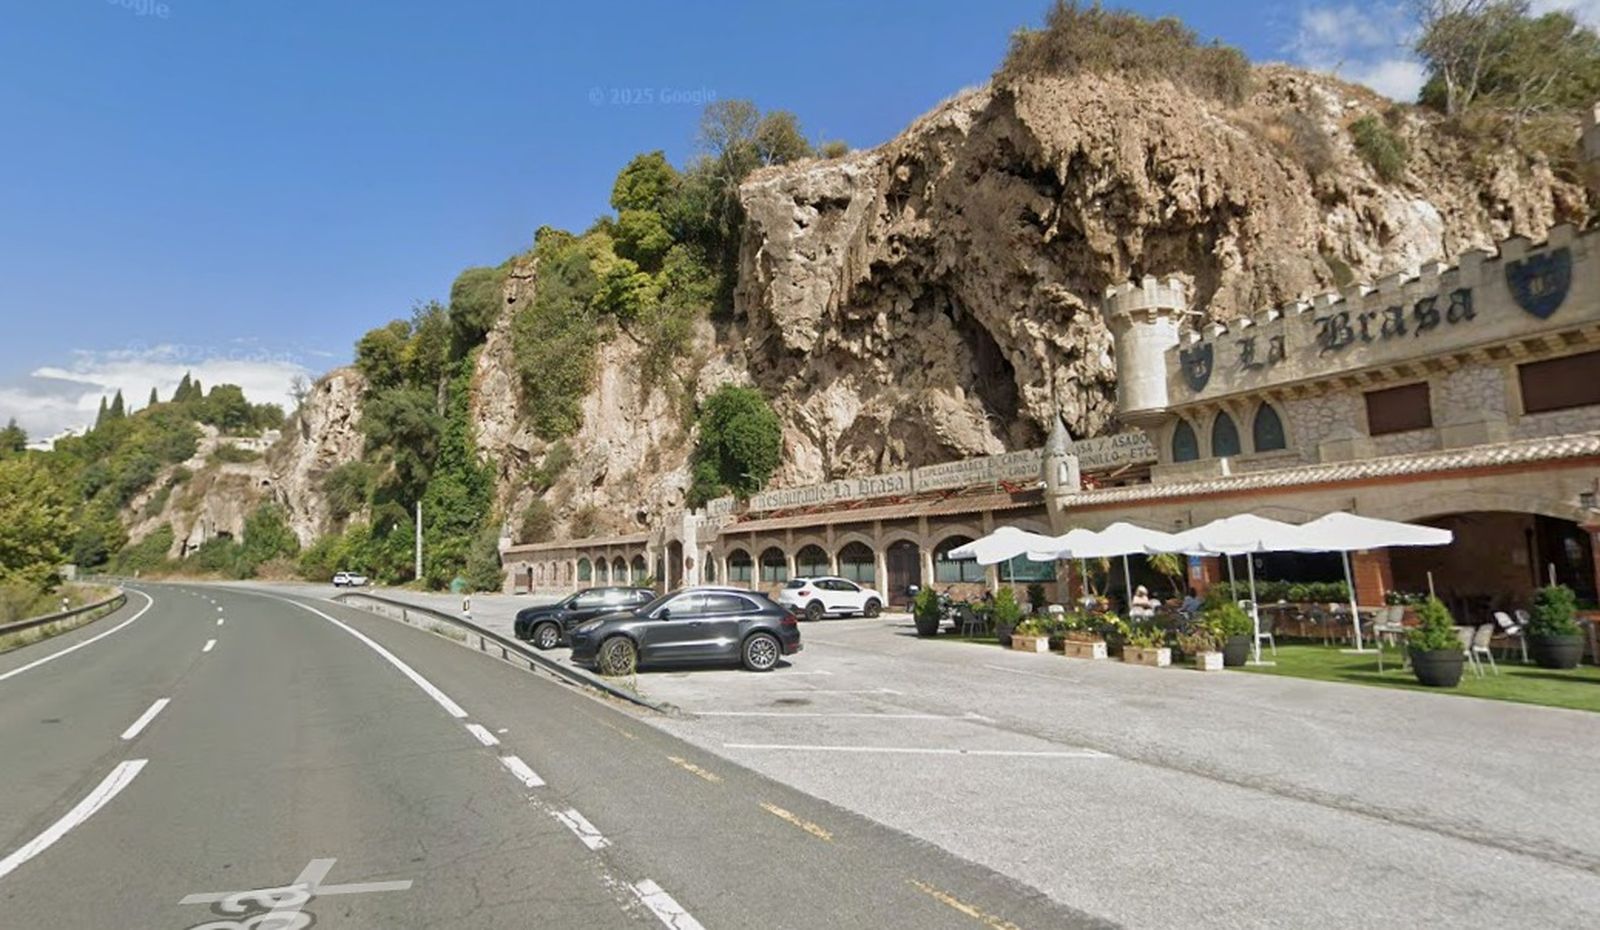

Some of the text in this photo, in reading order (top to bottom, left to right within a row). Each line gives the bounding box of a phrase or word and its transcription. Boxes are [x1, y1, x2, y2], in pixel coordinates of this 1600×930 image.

[1236, 333, 1285, 373] La
[1313, 286, 1477, 359] Brasa
[756, 486, 826, 509] Restaurante
[833, 481, 851, 498] La
[858, 475, 904, 495] Brasa
